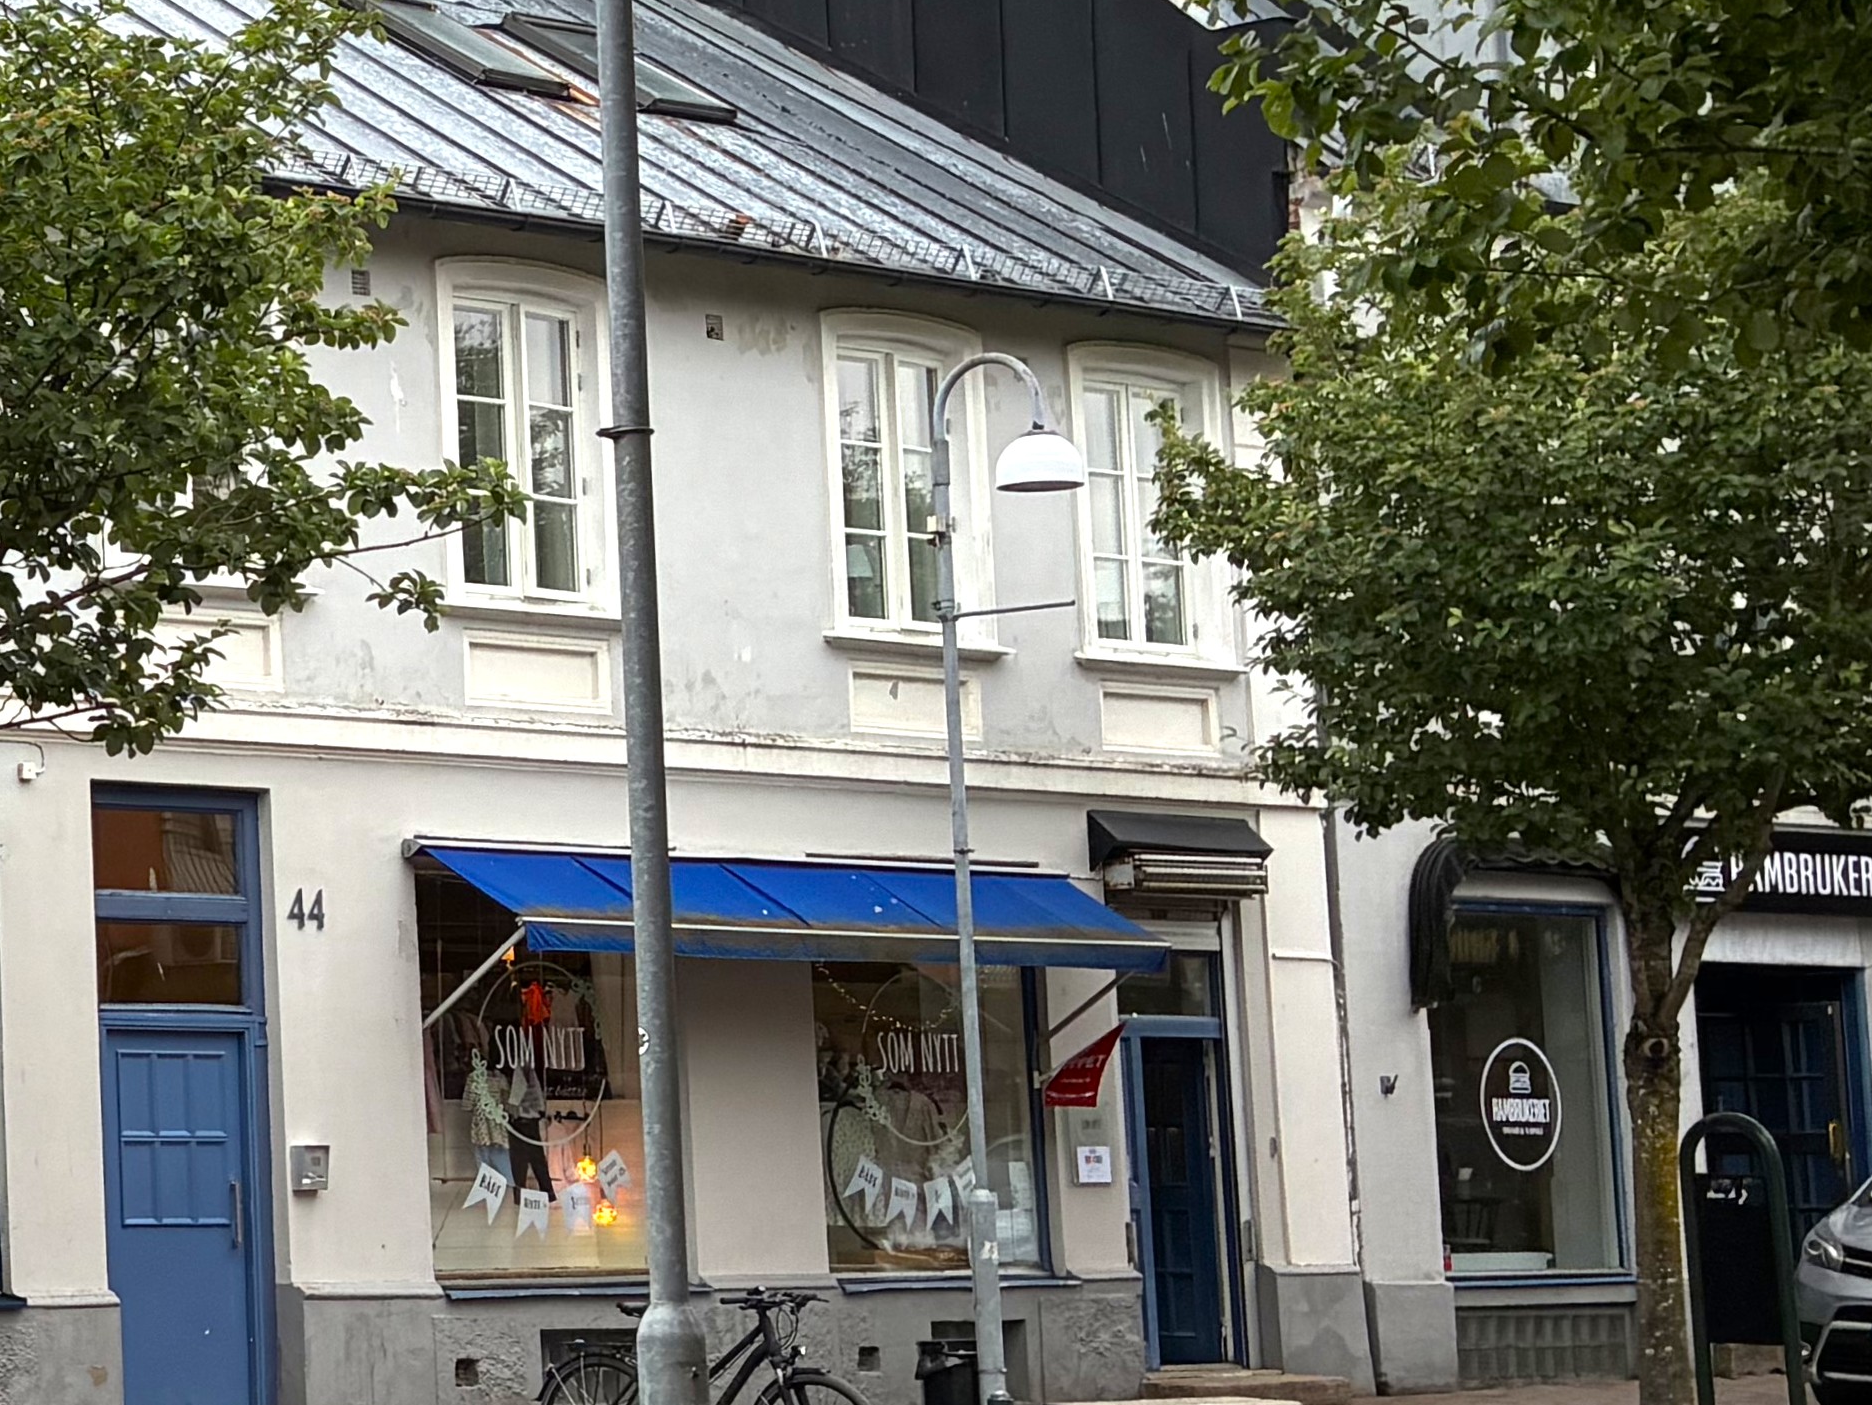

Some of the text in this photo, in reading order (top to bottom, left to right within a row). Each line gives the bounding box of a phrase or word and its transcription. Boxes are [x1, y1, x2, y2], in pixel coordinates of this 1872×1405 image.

[287, 887, 325, 931] 44
[494, 1025, 585, 1070] SOM NYTT
[877, 1032, 959, 1073] SOM NYTT
